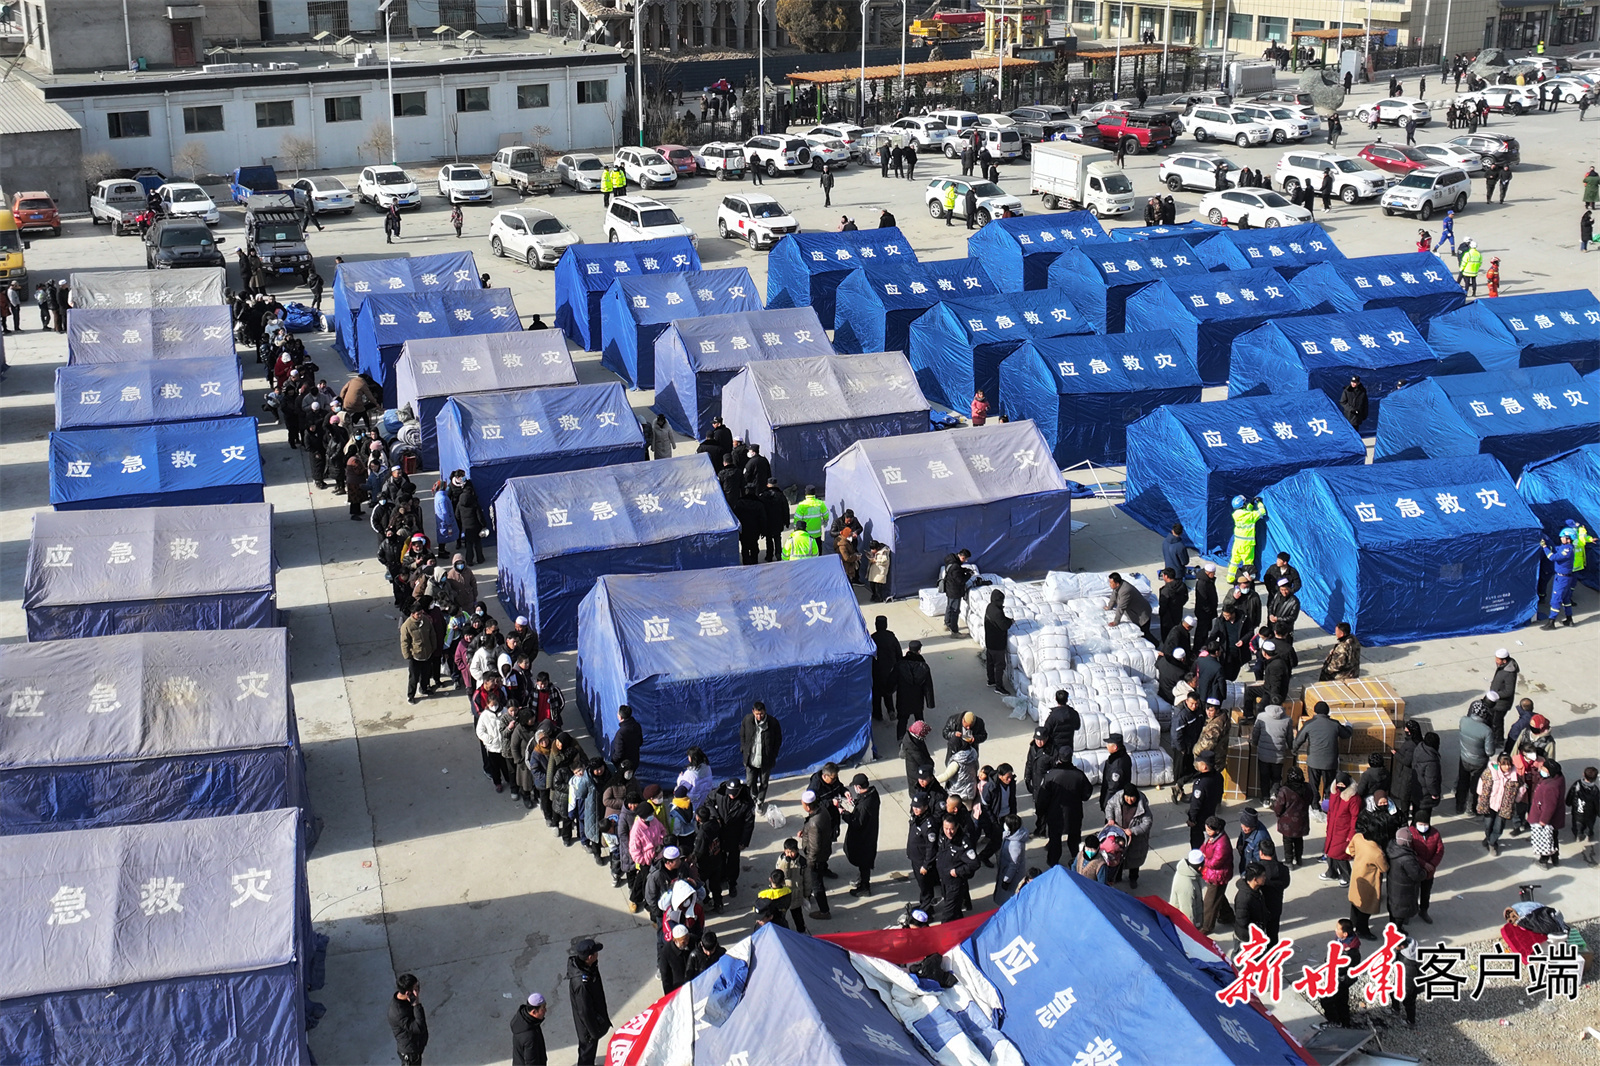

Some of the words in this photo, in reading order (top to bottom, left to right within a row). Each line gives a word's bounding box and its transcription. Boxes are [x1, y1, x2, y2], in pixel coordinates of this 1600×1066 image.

[1019, 227, 1097, 244] 应急救灾
[811, 245, 901, 261] 应急救灾
[1248, 241, 1327, 257] 应急救灾
[587, 255, 690, 274] 应急救灾
[1103, 255, 1191, 273] 应急救灾
[355, 270, 471, 292] 应急救灾
[885, 277, 981, 294] 应急救灾
[1355, 270, 1442, 288] 应急救灾
[633, 287, 746, 308] 应急救灾
[1190, 286, 1283, 307] 应急救灾
[379, 306, 509, 325] 应急救灾
[969, 308, 1071, 331] 应急救灾
[1510, 310, 1600, 331] 应急救灾
[81, 326, 223, 343] 应急救灾
[700, 330, 813, 353] 应急救灾
[1301, 331, 1409, 354] 应急救灾
[421, 351, 563, 375] 应急救灾
[1058, 353, 1176, 376] 应急救灾
[80, 382, 221, 404] 应急救灾
[768, 374, 908, 400] 应急救灾
[1470, 390, 1588, 417] 应急救灾
[482, 412, 619, 439] 应急救灾
[1202, 418, 1333, 447] 应急救灾
[66, 446, 246, 477] 应急救灾
[882, 449, 1039, 485] 应急救灾
[546, 488, 706, 527] 应急救灾
[1354, 488, 1506, 522] 应急救灾
[43, 535, 259, 567] 应急救灾
[643, 600, 832, 643] 应急救灾
